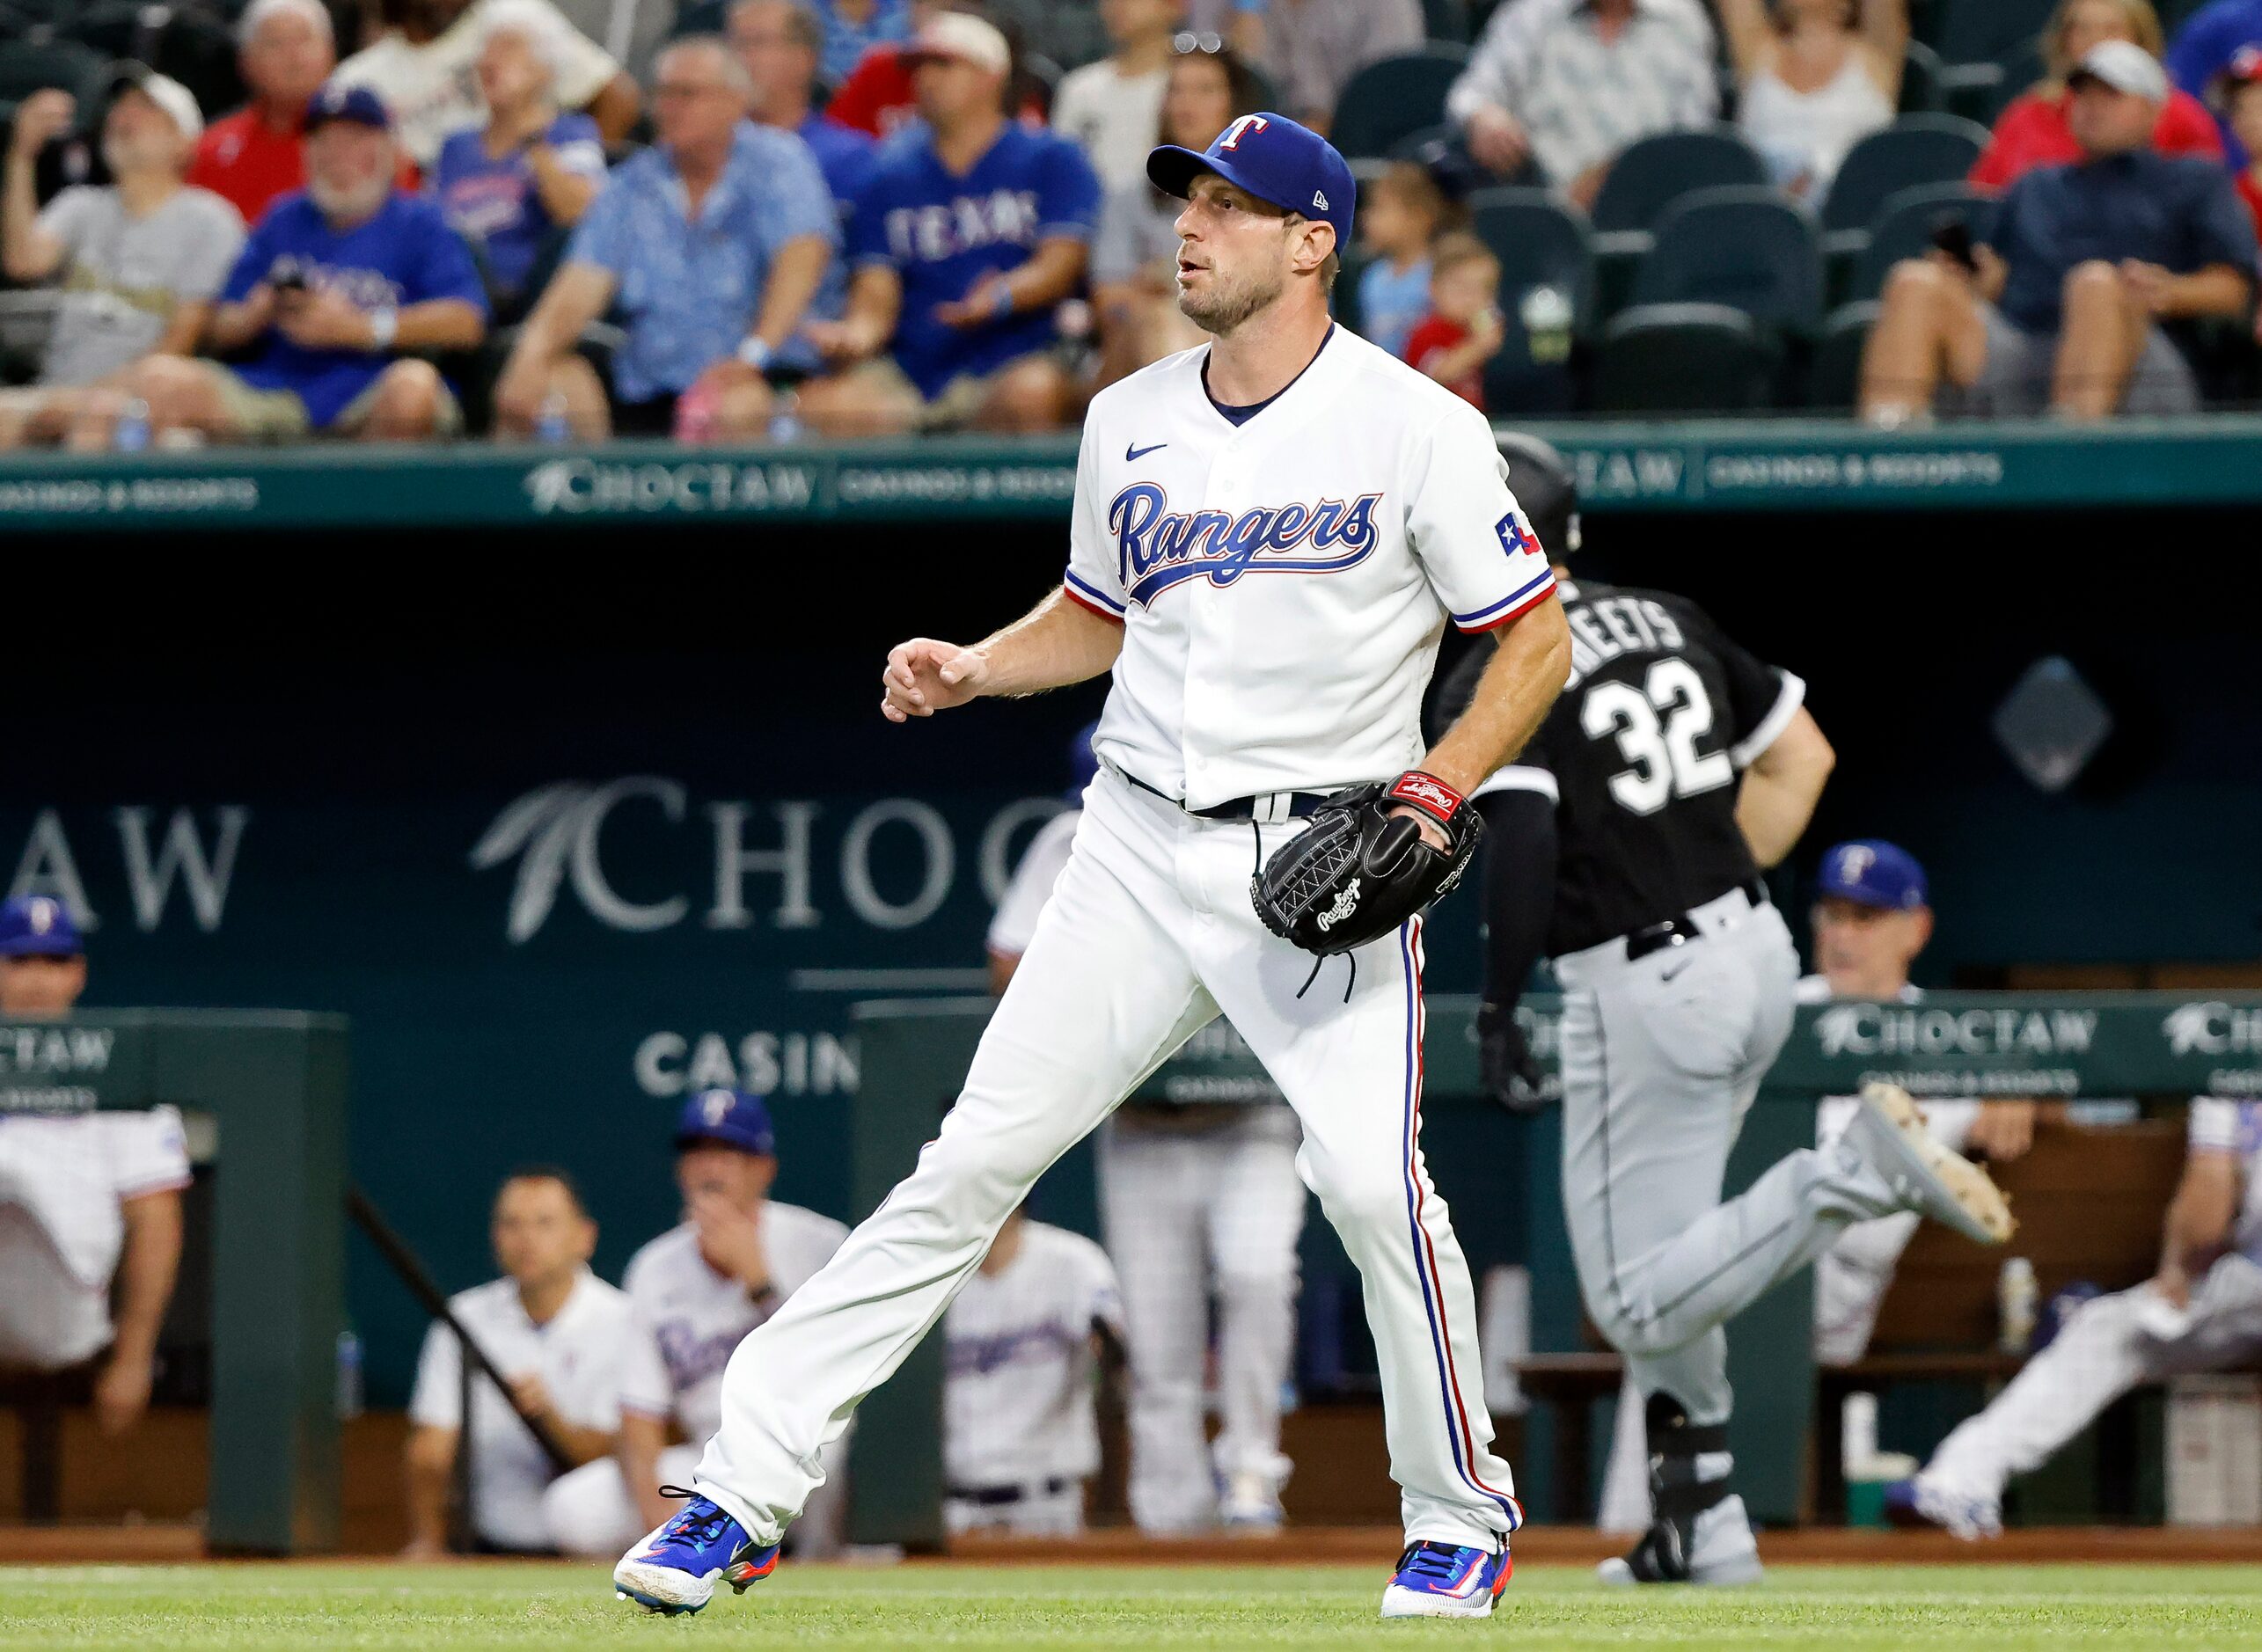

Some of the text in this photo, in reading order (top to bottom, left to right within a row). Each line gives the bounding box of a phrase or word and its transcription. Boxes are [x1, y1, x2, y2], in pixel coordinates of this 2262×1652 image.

[565, 457, 816, 514] CHOCTAW
[1108, 480, 1384, 600] Rangers
[1580, 656, 1733, 816] 32
[1317, 878, 1361, 932] Rawlings
[1846, 1004, 2097, 1055] CHOCTAW
